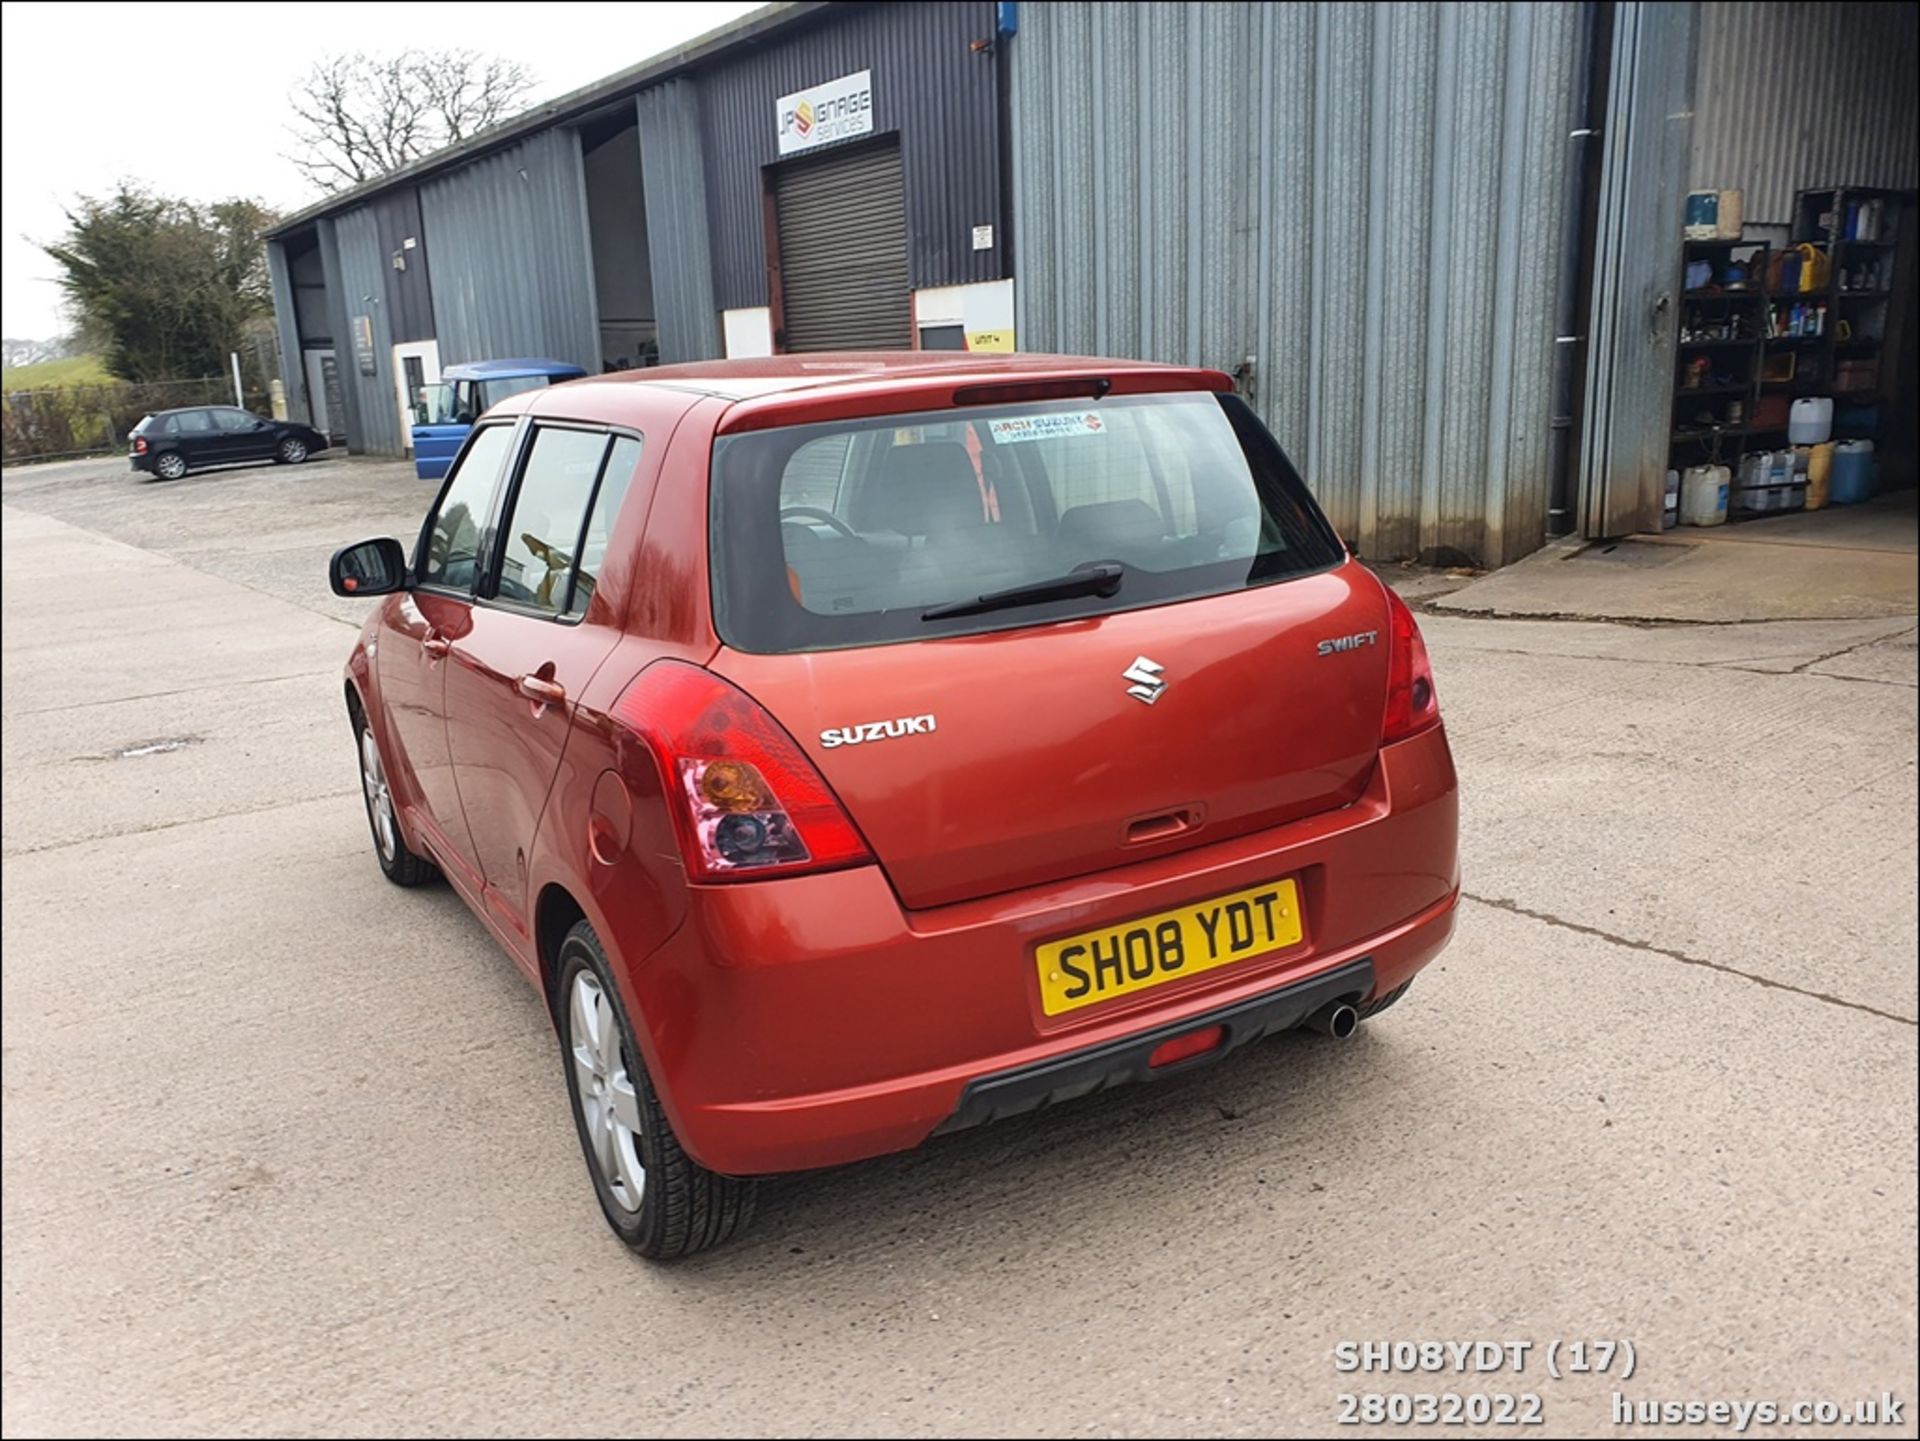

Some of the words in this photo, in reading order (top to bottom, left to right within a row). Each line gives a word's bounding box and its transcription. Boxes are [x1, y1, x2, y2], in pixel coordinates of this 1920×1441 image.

[1316, 630, 1377, 656] SWIFT
[819, 713, 937, 749] SUZUKI
[1058, 919, 1185, 1000] SH08
[1195, 891, 1279, 959] YDT
